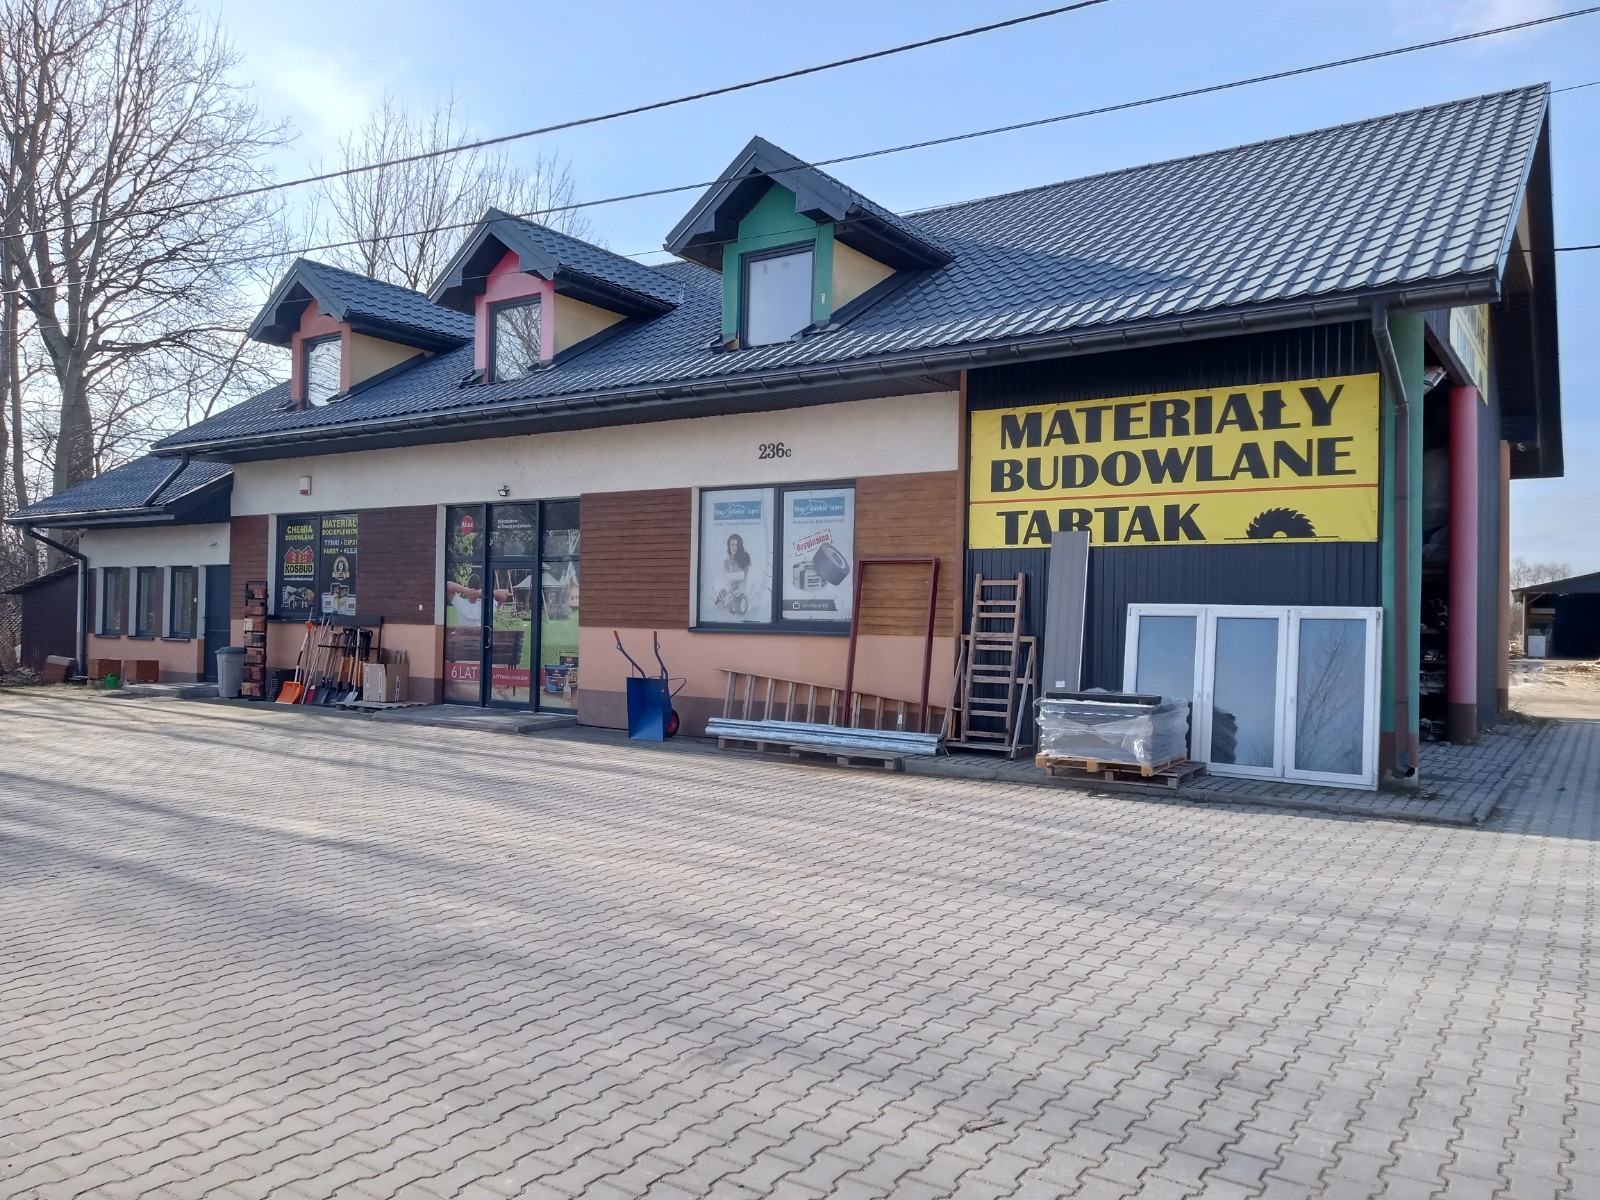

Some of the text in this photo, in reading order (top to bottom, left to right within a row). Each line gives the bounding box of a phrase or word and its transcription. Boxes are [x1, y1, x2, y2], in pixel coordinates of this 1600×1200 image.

[1000, 384, 1344, 450] MATERIAŁY
[758, 442, 792, 460] 236c
[990, 436, 1357, 493] BUDOWLANE
[287, 525, 312, 533] CHEMIA
[996, 503, 1206, 546] TARTAK
[285, 565, 313, 573] KOSBUD
[451, 666, 477, 679] 6 LAT
